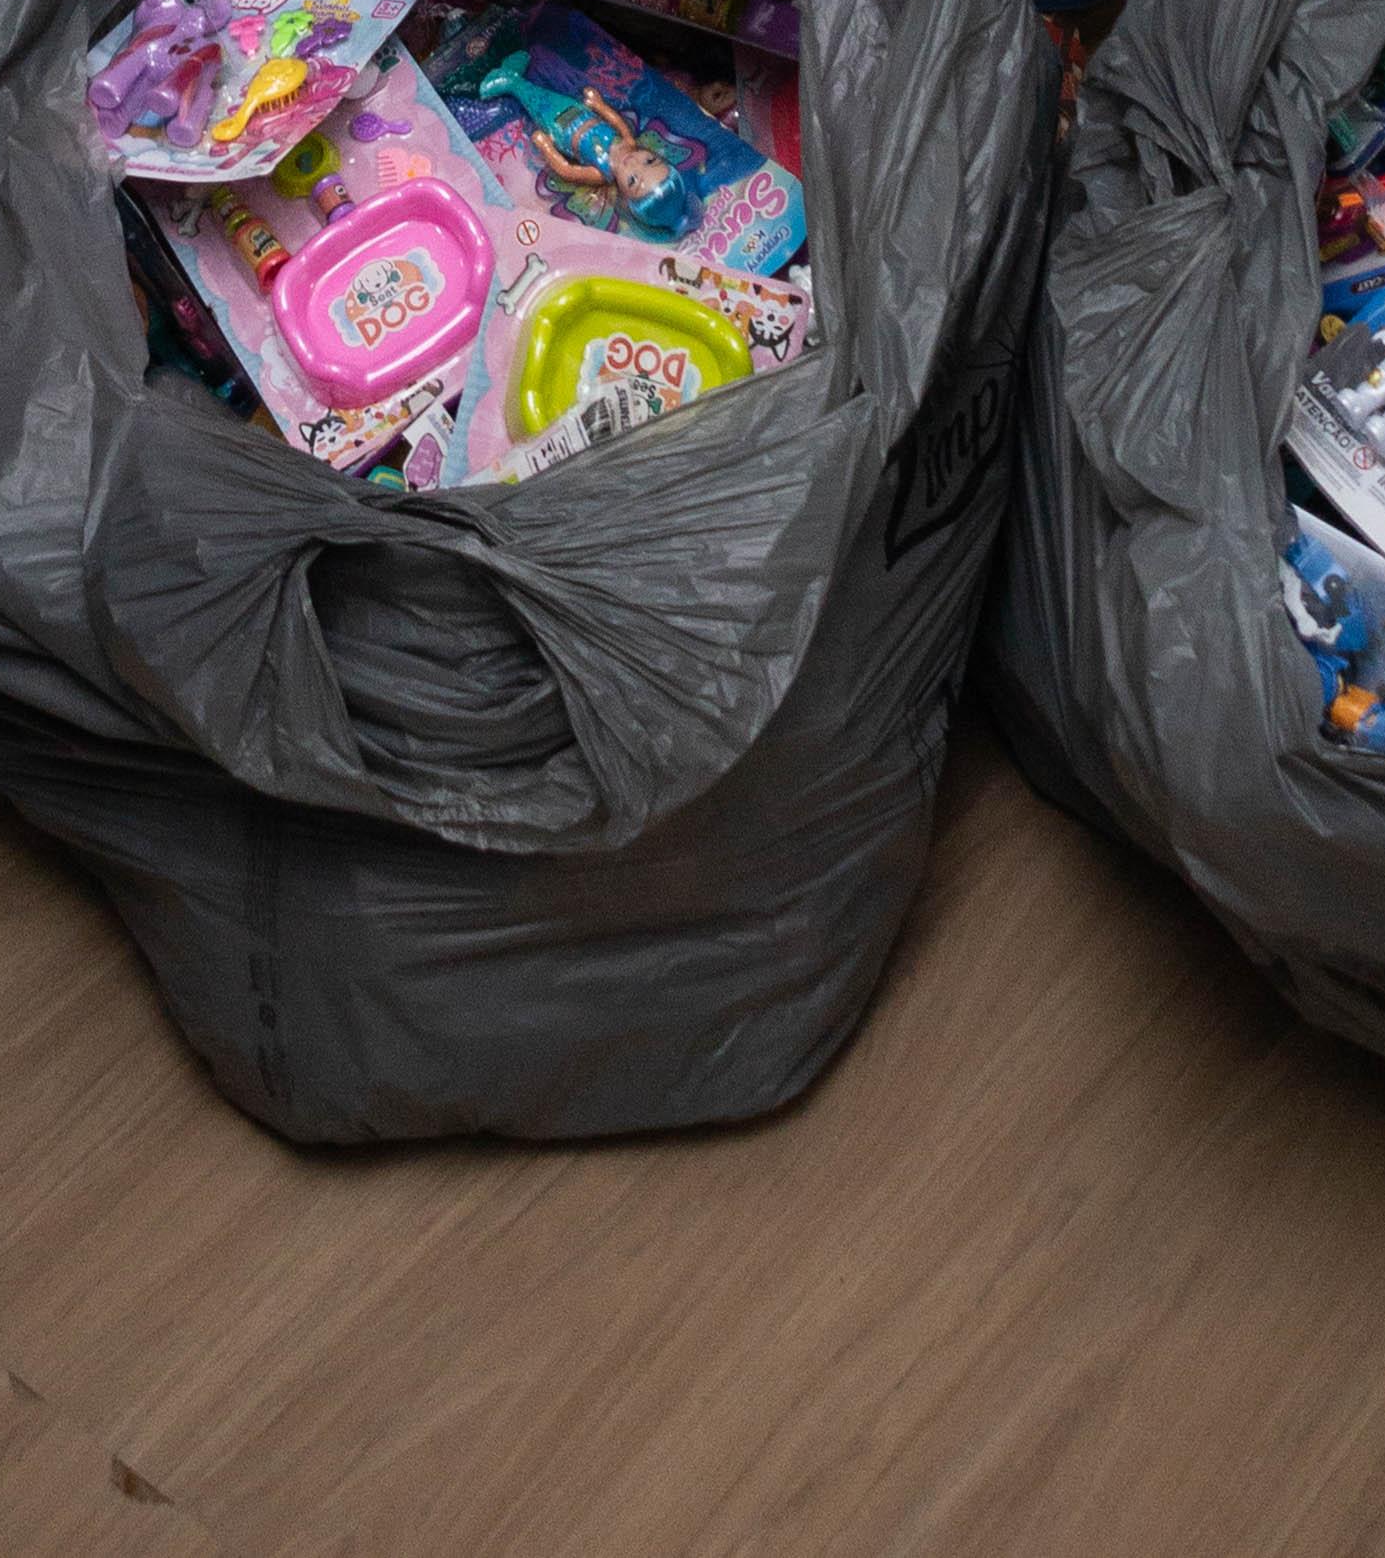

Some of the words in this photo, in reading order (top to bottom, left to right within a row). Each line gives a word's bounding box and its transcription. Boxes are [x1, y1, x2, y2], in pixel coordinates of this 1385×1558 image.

[355, 284, 431, 347] DOG
[368, 286, 398, 308] Seat
[606, 336, 687, 388] DOG
[631, 378, 657, 400] Sea
[1295, 390, 1357, 454] ATENÇÃO!
